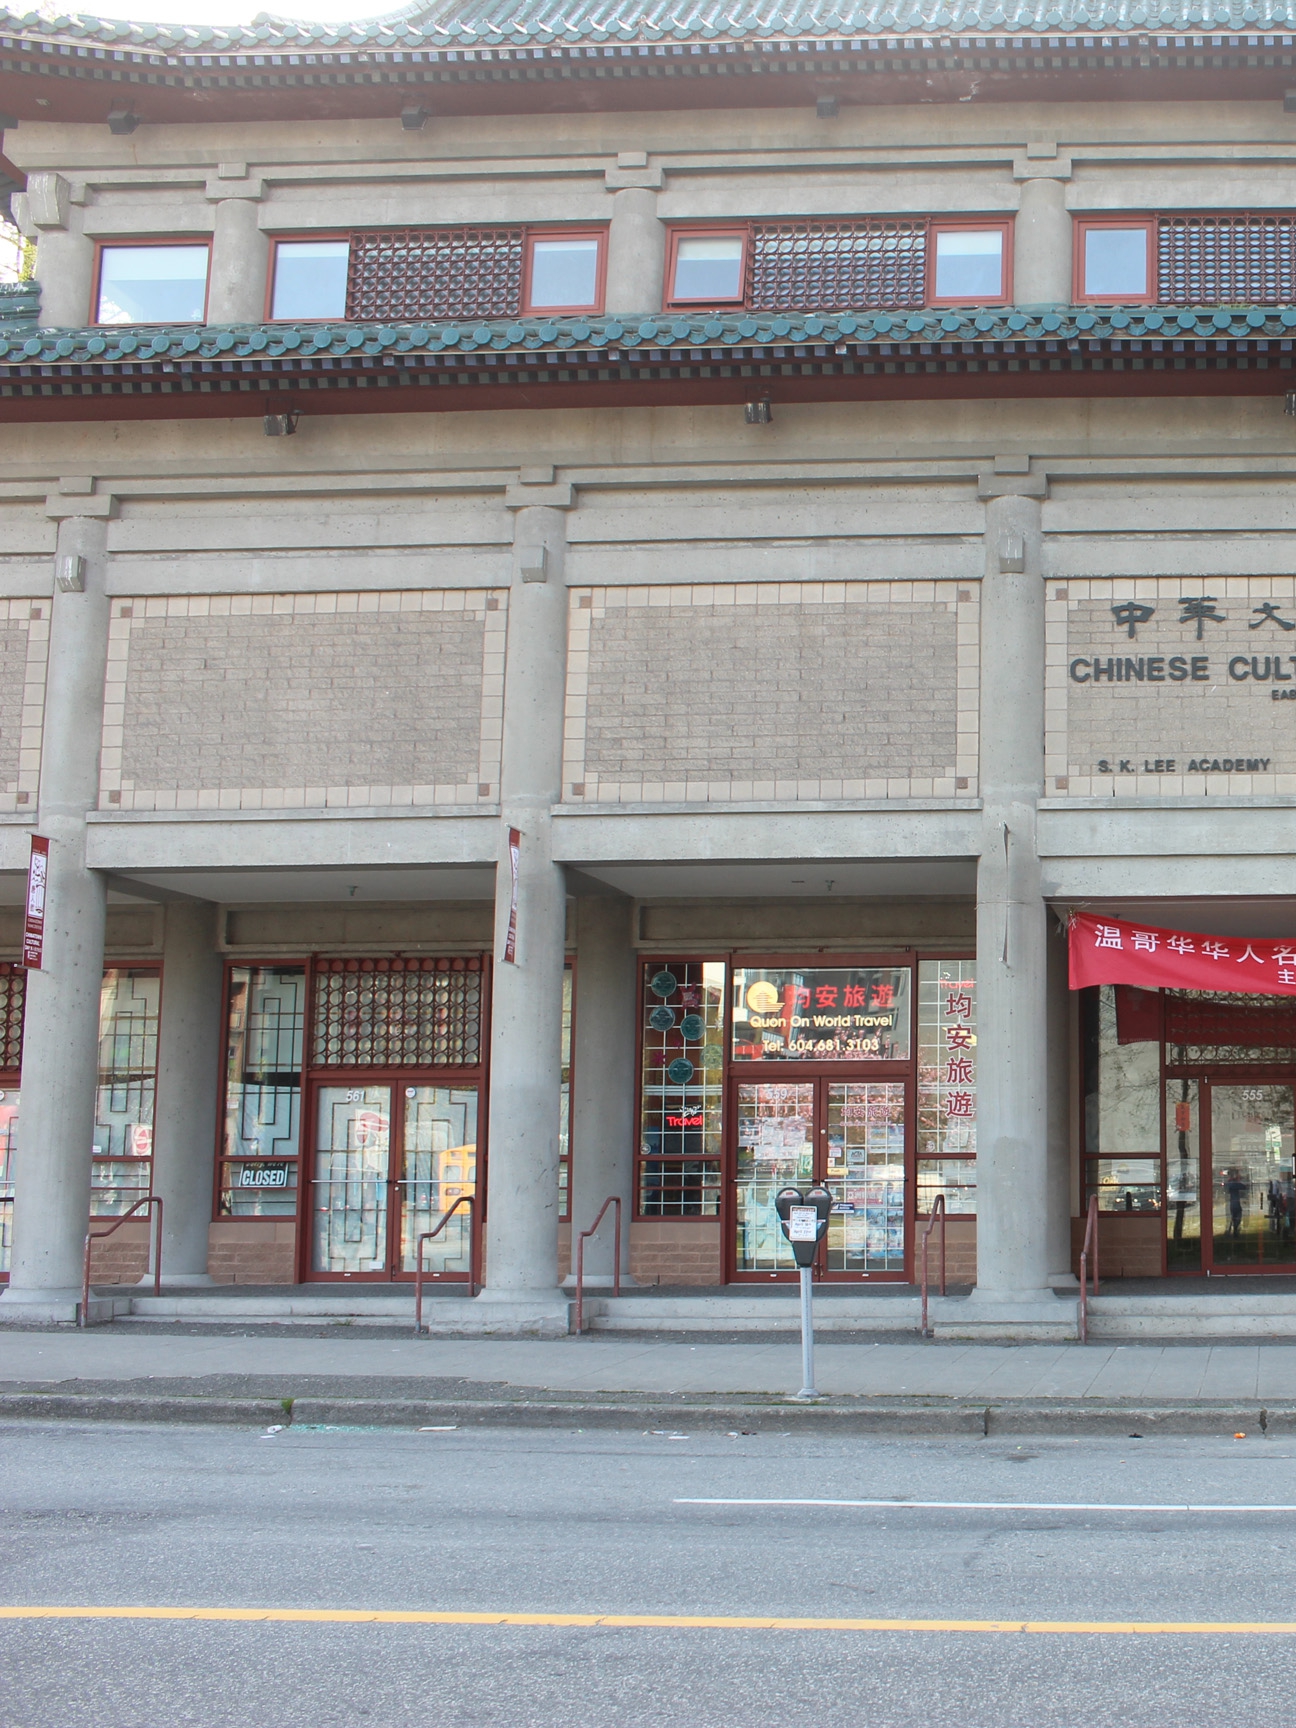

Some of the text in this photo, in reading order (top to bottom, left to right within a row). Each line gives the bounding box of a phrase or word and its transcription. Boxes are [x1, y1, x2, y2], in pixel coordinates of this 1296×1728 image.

[1070, 656, 1210, 683] CHINESE
[1098, 758, 1271, 773] S. K. LEE ACADEMY
[789, 984, 895, 1009] 均安旅遊
[750, 1014, 893, 1028] Quon On World Travel
[763, 1039, 879, 1052] Tel: 604.681.3103
[945, 992, 974, 1119] 均安旅遊
[346, 1090, 365, 1102] 561
[766, 1088, 788, 1100] 559
[1242, 1089, 1263, 1100] 555
[666, 1114, 703, 1127] Travel
[242, 1169, 285, 1186] CLOSED
